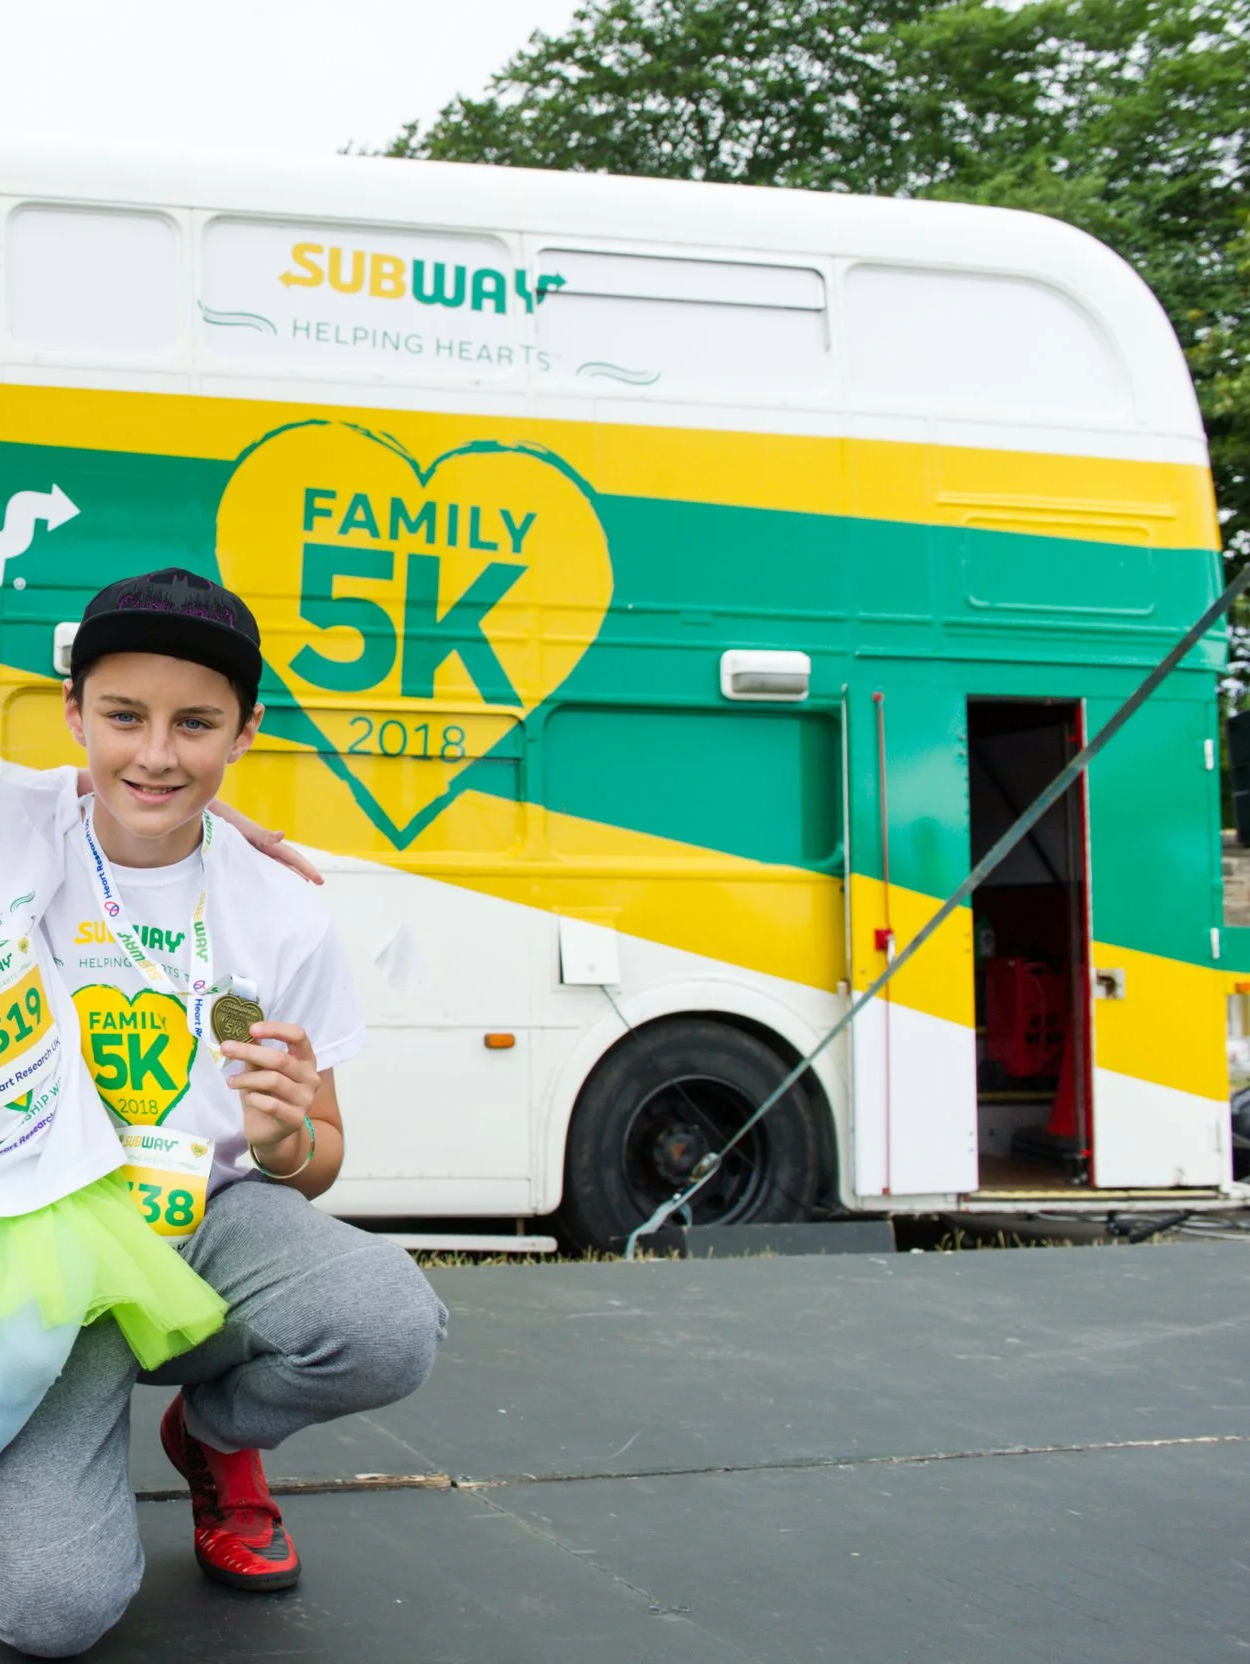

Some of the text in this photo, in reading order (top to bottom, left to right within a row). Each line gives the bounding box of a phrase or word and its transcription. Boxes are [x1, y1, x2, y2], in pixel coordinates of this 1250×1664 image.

[279, 242, 567, 316] SUBWAY
[292, 318, 551, 372] HELPING HEARTS
[303, 487, 537, 554] FAMILY
[288, 541, 529, 708] 5K
[348, 716, 467, 764] 2018
[98, 871, 113, 900] Heart
[79, 957, 133, 969] HELPING
[116, 931, 164, 982] SUBWAY
[89, 1011, 167, 1032] FAMILY
[14, 1048, 52, 1083] Research
[90, 1032, 180, 1091] 5K
[118, 1098, 159, 1116] 2018
[124, 1135, 180, 1152] SUBWAY
[128, 1182, 195, 1227] 38
